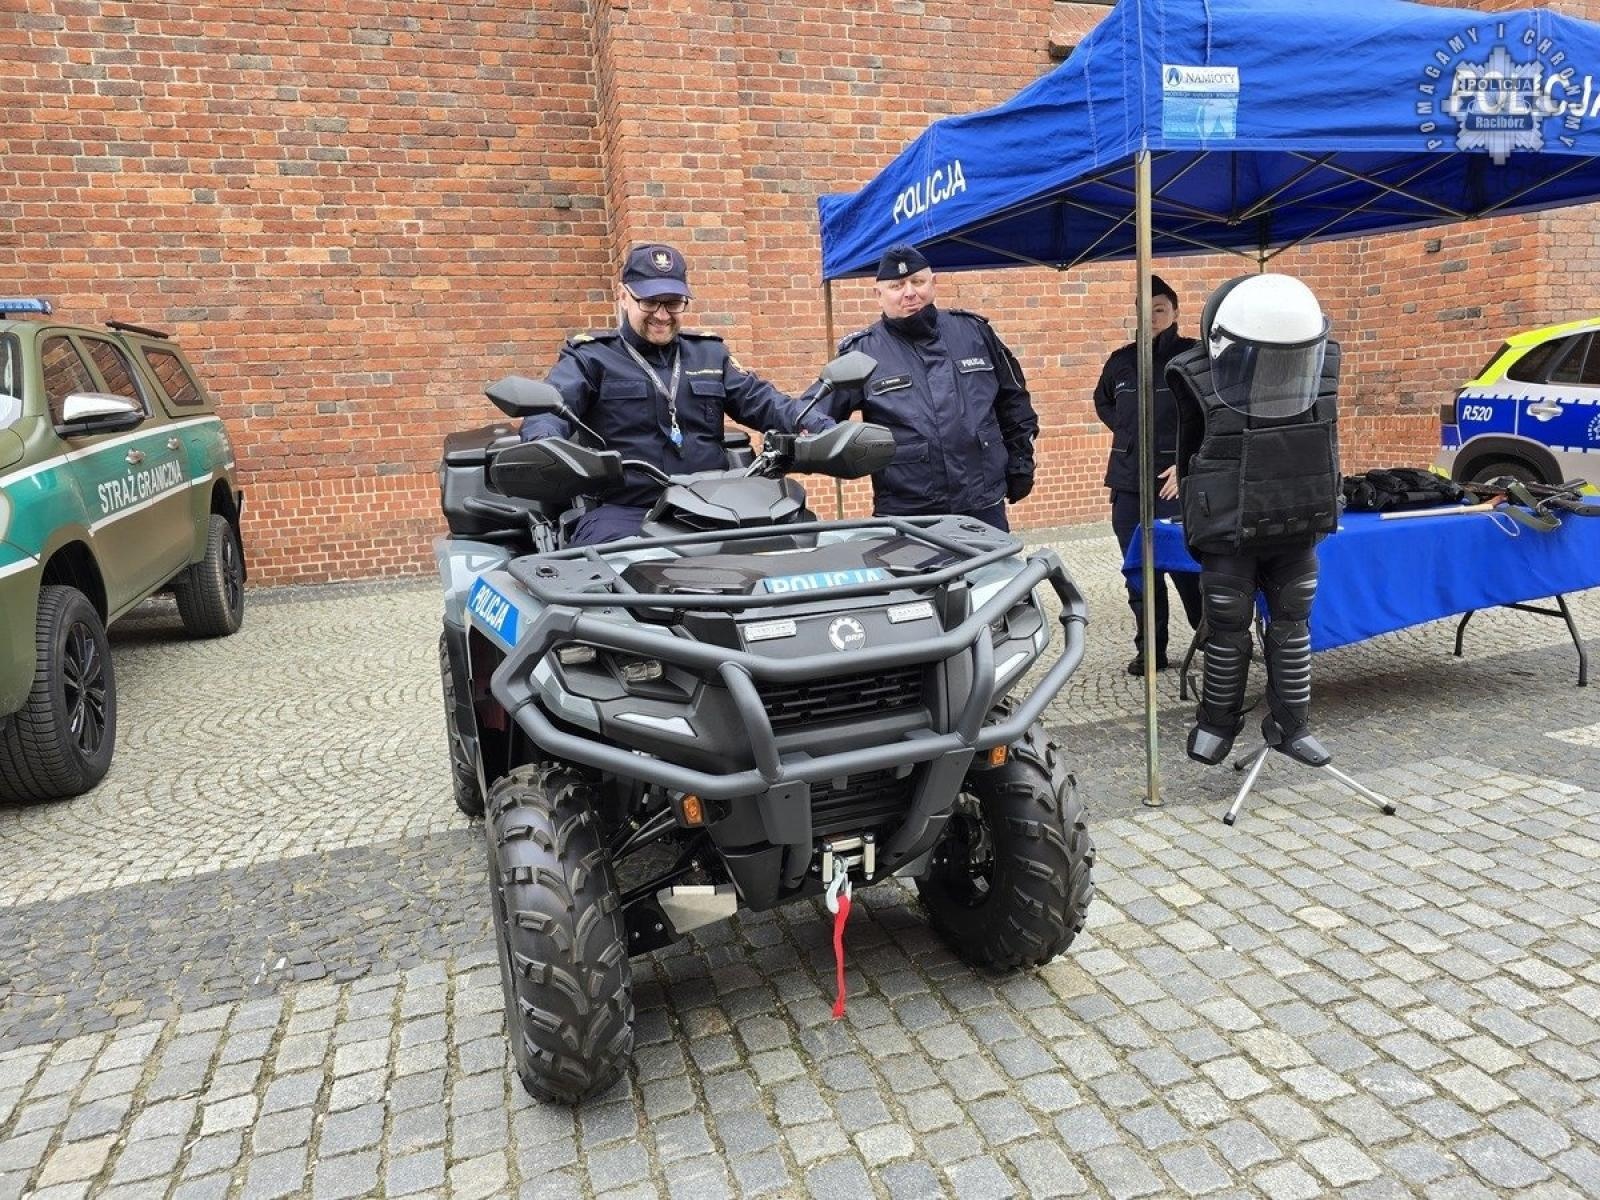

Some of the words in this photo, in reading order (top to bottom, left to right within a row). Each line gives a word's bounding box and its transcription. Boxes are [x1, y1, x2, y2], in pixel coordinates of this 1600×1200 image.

[892, 159, 967, 224] POLICJA
[1462, 405, 1493, 422] R520
[98, 469, 138, 513] STRAŻ
[137, 460, 183, 499] GRANICZNA
[471, 584, 510, 632] POLICJA
